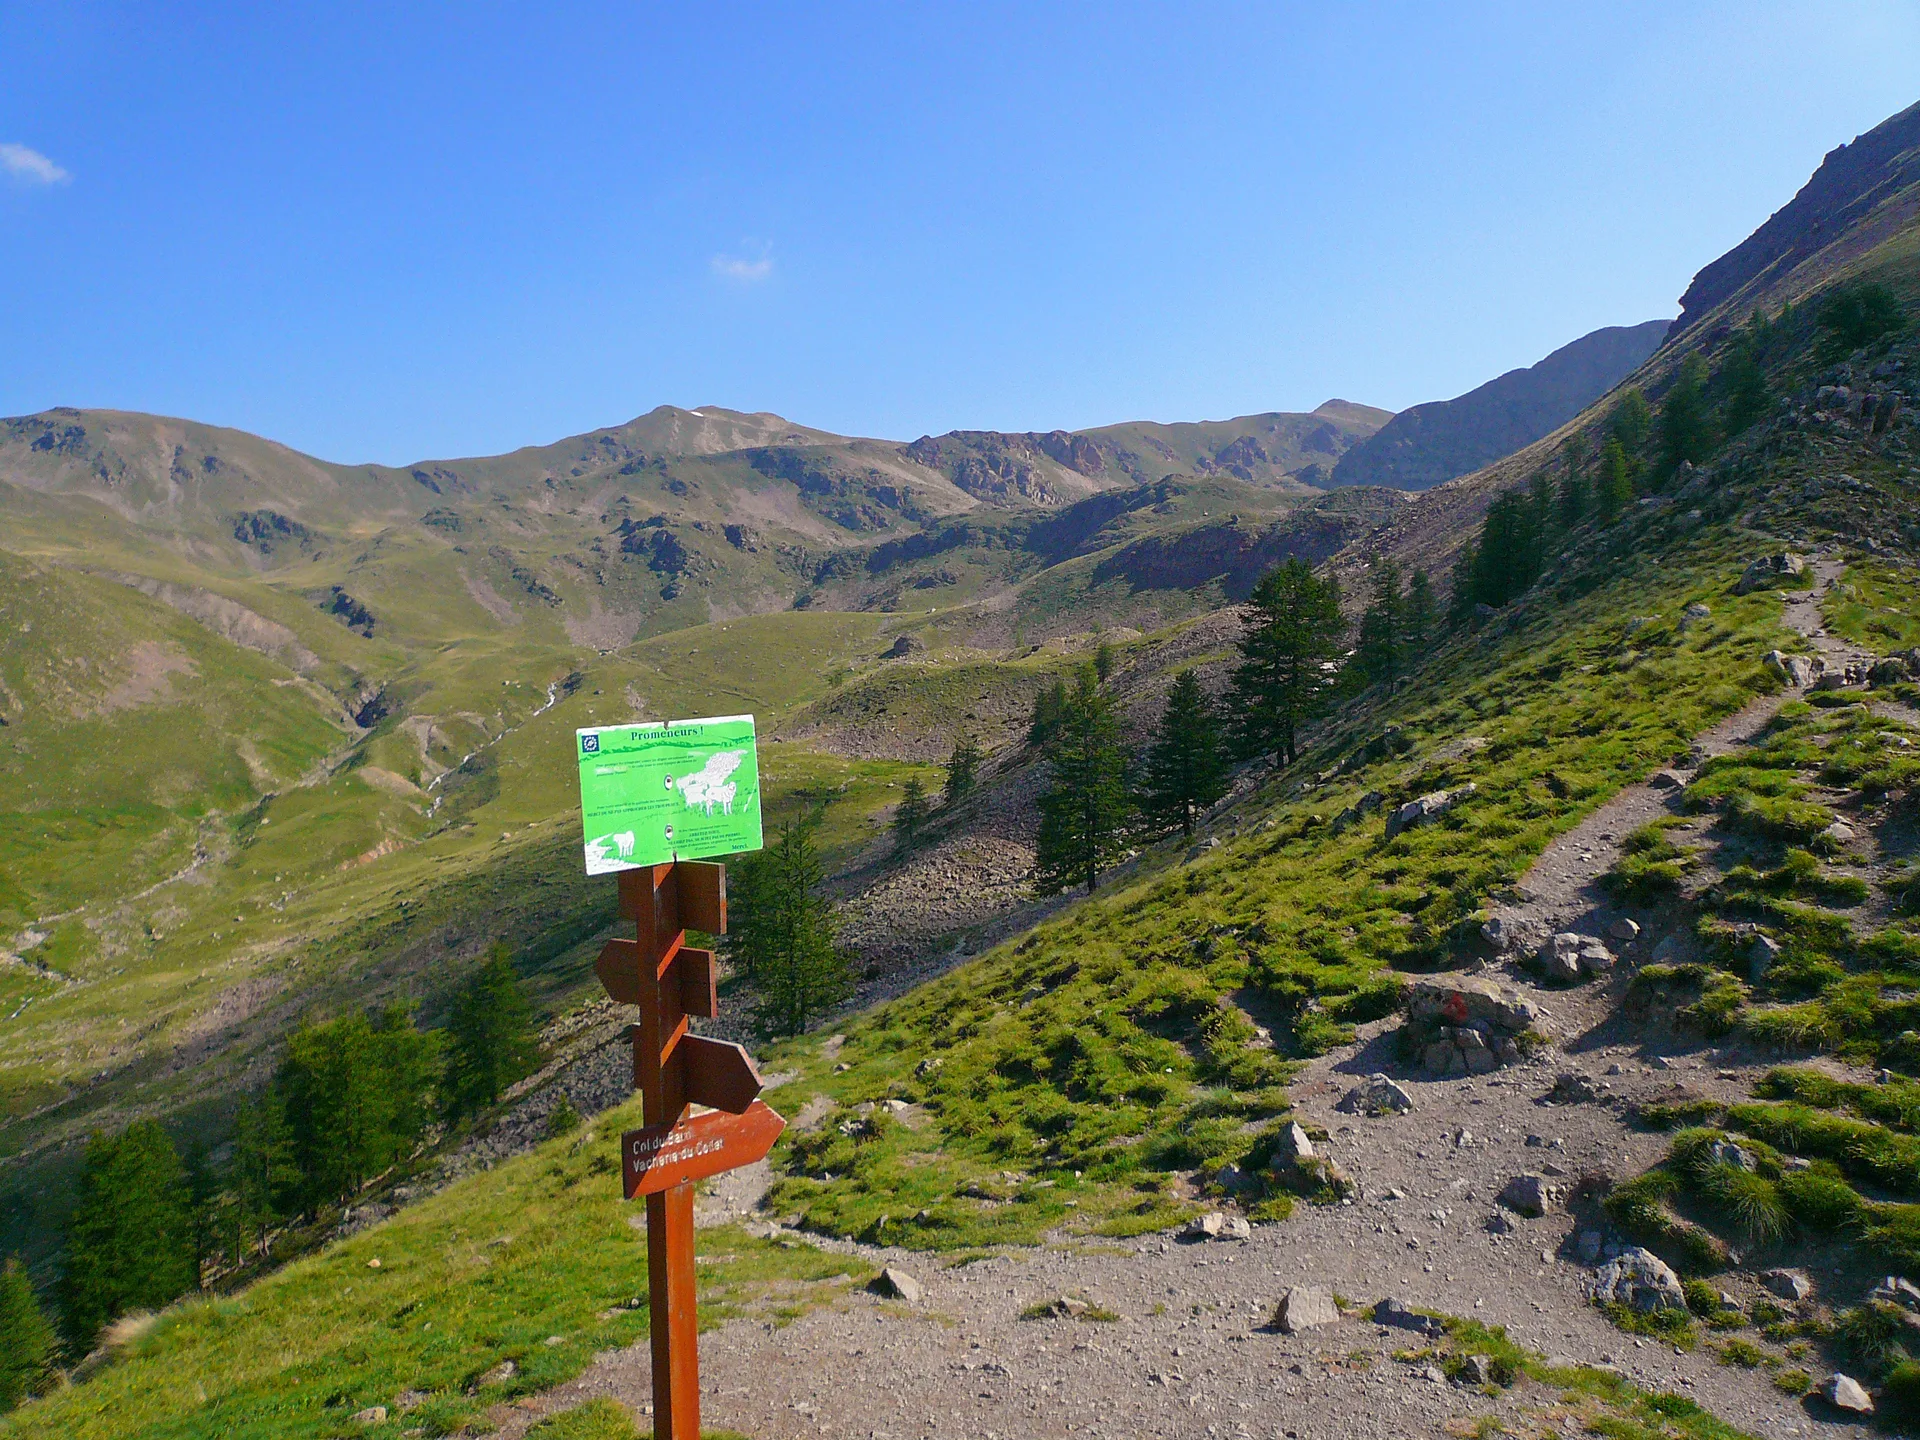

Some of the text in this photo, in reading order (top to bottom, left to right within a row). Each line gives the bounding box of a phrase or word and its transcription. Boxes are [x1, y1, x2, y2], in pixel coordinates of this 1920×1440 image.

[633, 1138, 650, 1155] Col
[652, 1135, 665, 1150] du
[633, 1152, 678, 1173] Vacherie
[681, 1146, 694, 1160] du
